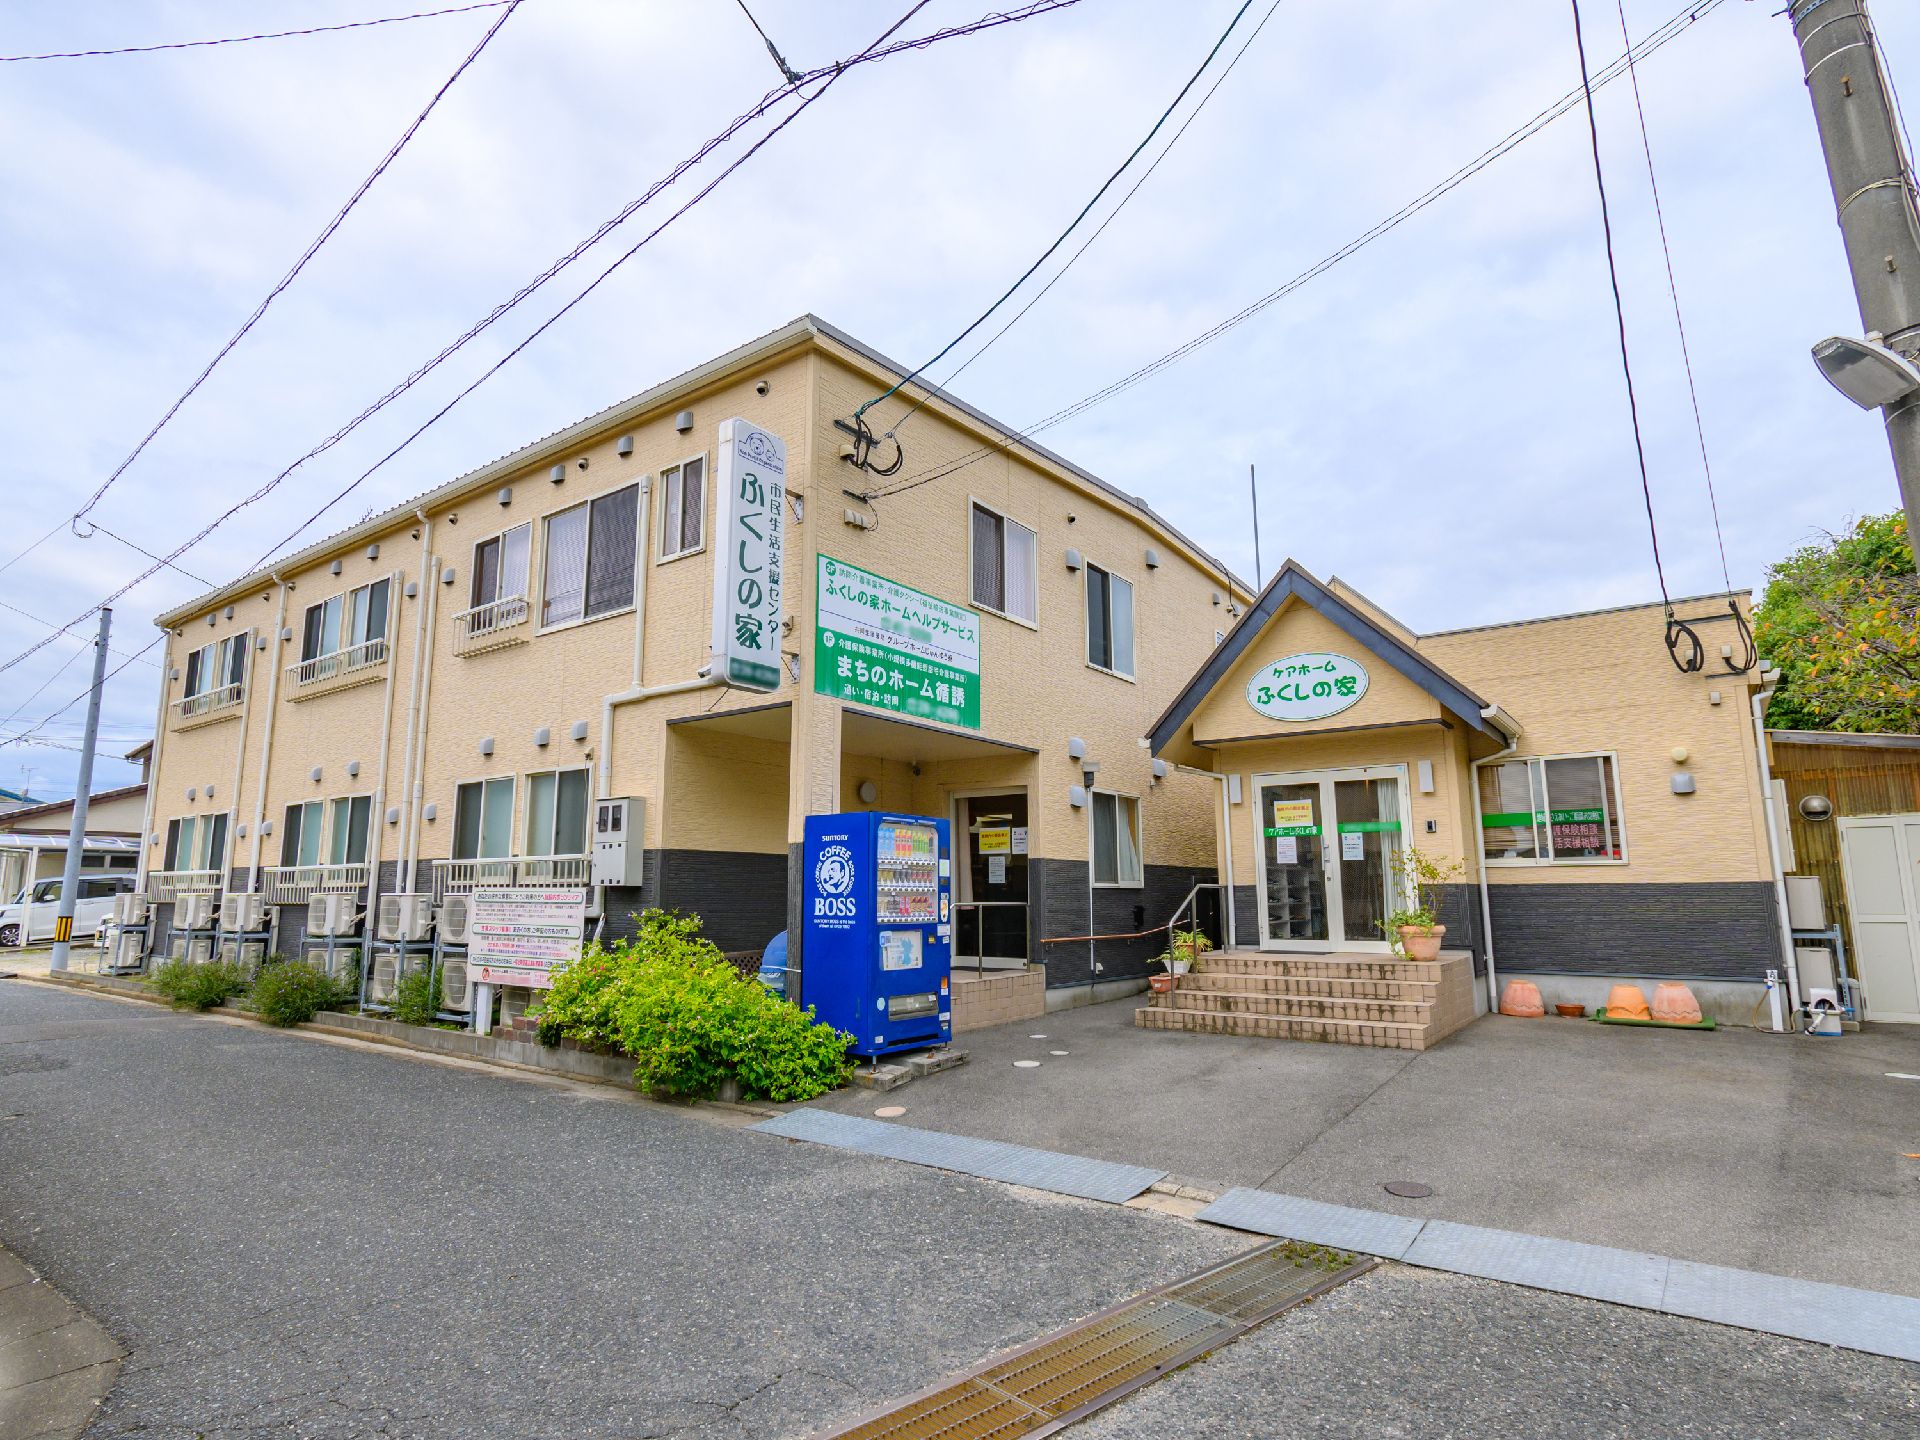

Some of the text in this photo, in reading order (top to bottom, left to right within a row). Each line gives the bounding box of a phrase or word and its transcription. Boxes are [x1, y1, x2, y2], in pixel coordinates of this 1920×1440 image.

[735, 472, 765, 651] ふくしの家
[768, 482, 783, 651] 市民生活支援センター
[826, 563, 836, 574] 2F
[825, 579, 975, 643] ふくしの家ホームヘルプサービス
[1273, 660, 1337, 678] ケアホーム
[837, 655, 965, 708] まちのホーム循誘
[1257, 675, 1357, 705] ふくしの家
[821, 834, 849, 842] SUNTORY
[1544, 823, 1598, 836] 護保険相談
[1546, 836, 1600, 849] 活支援相談
[819, 845, 852, 861] COFFEE
[814, 897, 857, 917] BOSS
